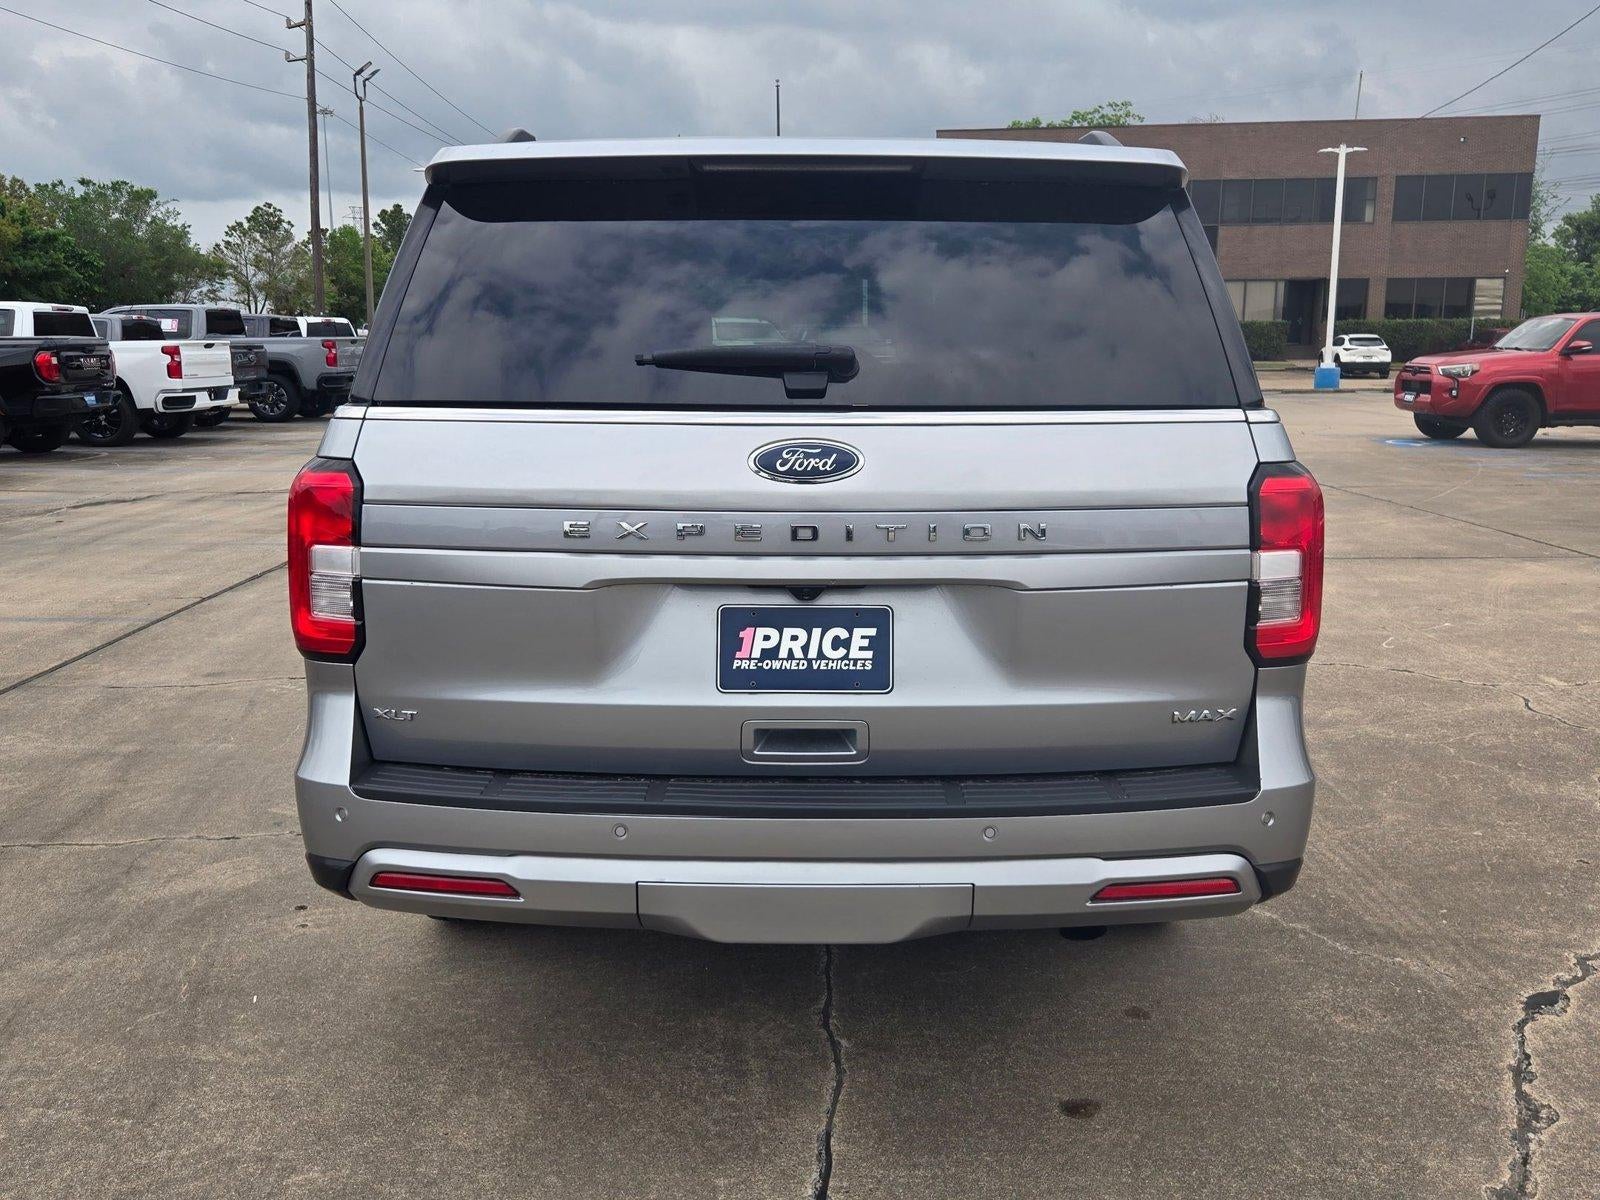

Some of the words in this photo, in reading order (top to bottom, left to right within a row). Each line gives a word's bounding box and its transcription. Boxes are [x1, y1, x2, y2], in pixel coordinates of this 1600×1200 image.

[776, 447, 837, 471] Ford
[562, 520, 1048, 542] EXPEDITION
[735, 627, 877, 659] 1PRICE
[733, 659, 808, 670] PRE-OWNED
[812, 659, 872, 670] VEHICLES
[373, 707, 418, 721] XLT
[1172, 708, 1237, 723] MAX
